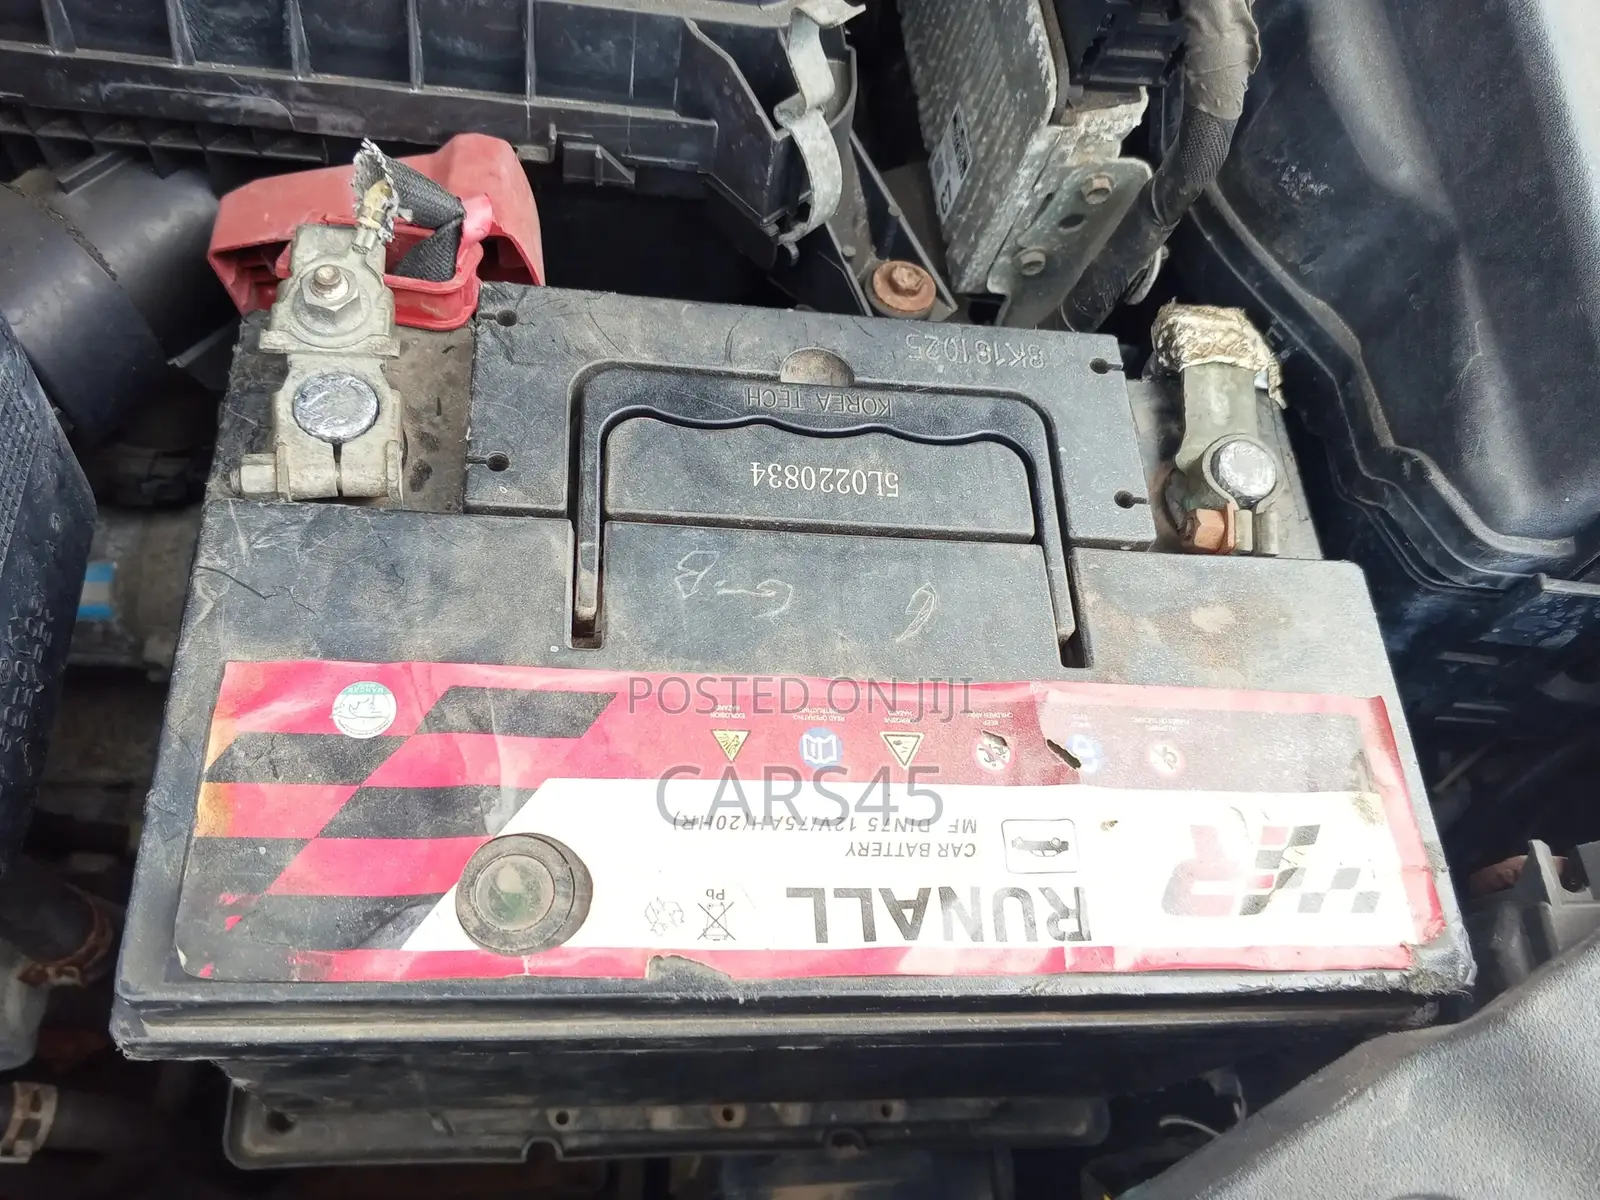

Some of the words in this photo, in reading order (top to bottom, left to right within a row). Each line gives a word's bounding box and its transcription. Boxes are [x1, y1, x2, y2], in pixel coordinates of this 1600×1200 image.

[744, 388, 803, 409] TECH
[816, 392, 892, 416] KOREA
[750, 461, 900, 498] 5L0220834
[672, 811, 858, 833] 12V/75AH(20HR)
[867, 817, 931, 834] DIN75
[947, 818, 977, 834] MF
[844, 841, 931, 859] BATTERY
[936, 841, 977, 858] CAR
[705, 888, 726, 901] Pb
[785, 886, 1092, 944] RUNALL
